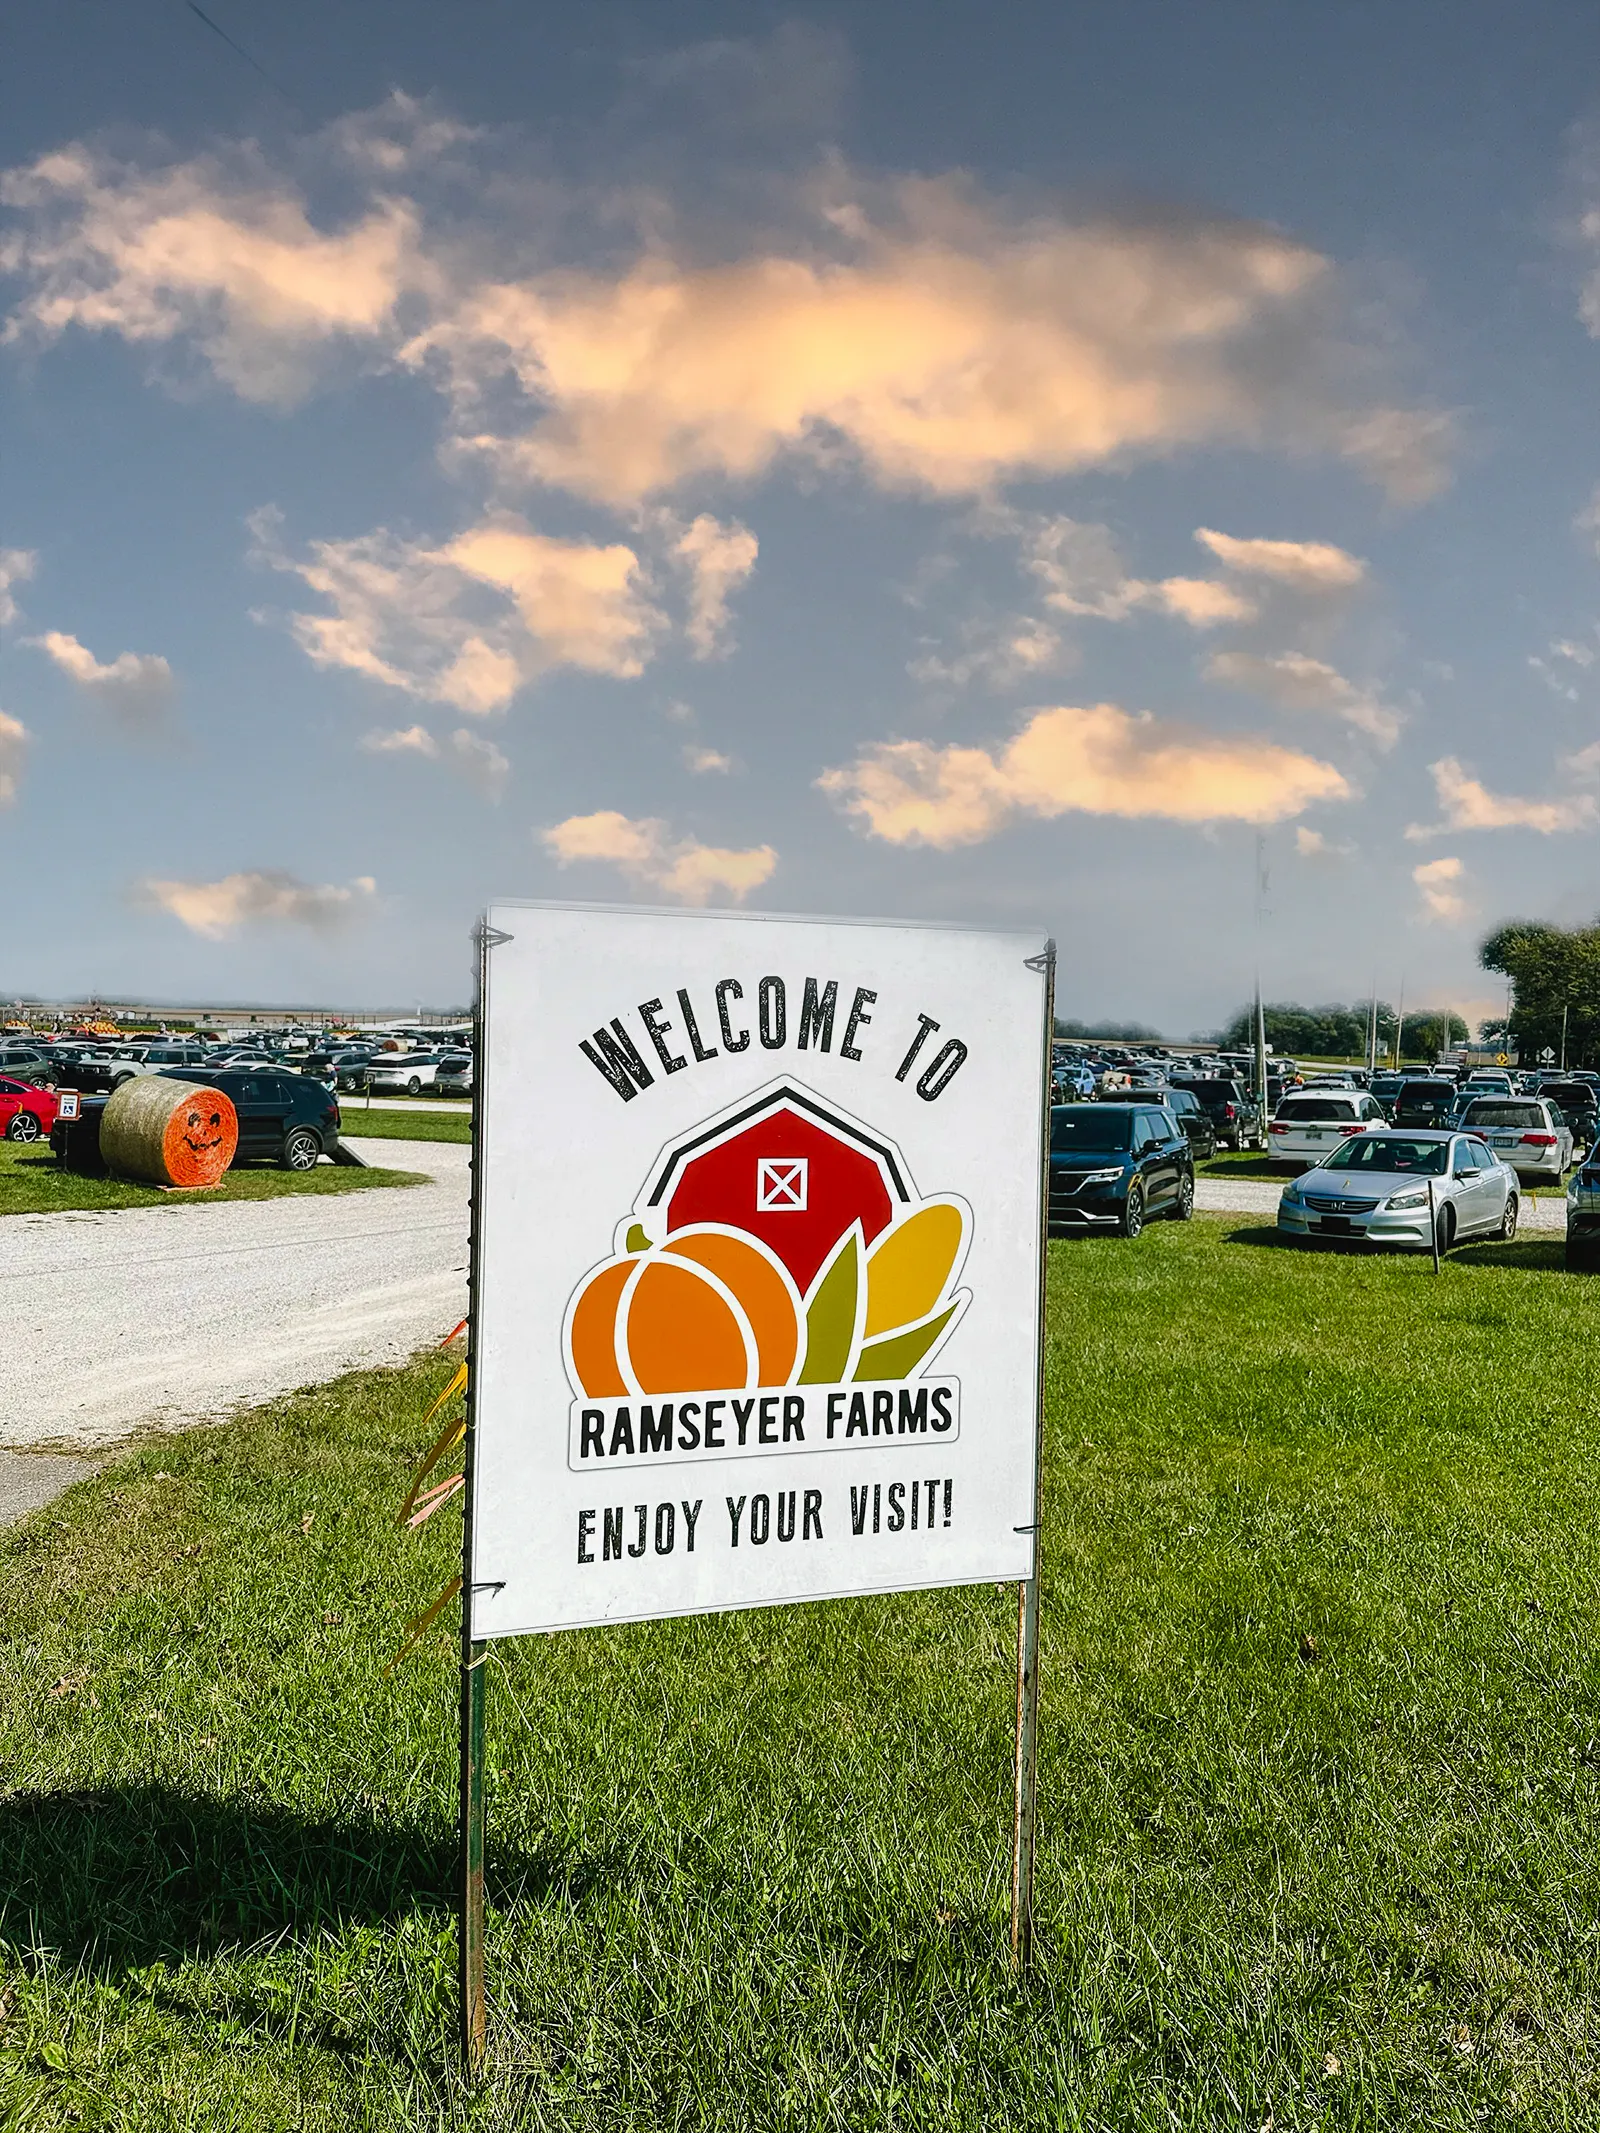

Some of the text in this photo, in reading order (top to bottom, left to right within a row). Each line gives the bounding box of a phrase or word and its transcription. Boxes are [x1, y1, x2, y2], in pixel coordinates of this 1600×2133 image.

[578, 976, 968, 1102] WELCOME TO
[580, 1387, 952, 1458] RAMSEYER FARMS
[578, 1479, 953, 1564] ENJOY YOUR VISIT!
